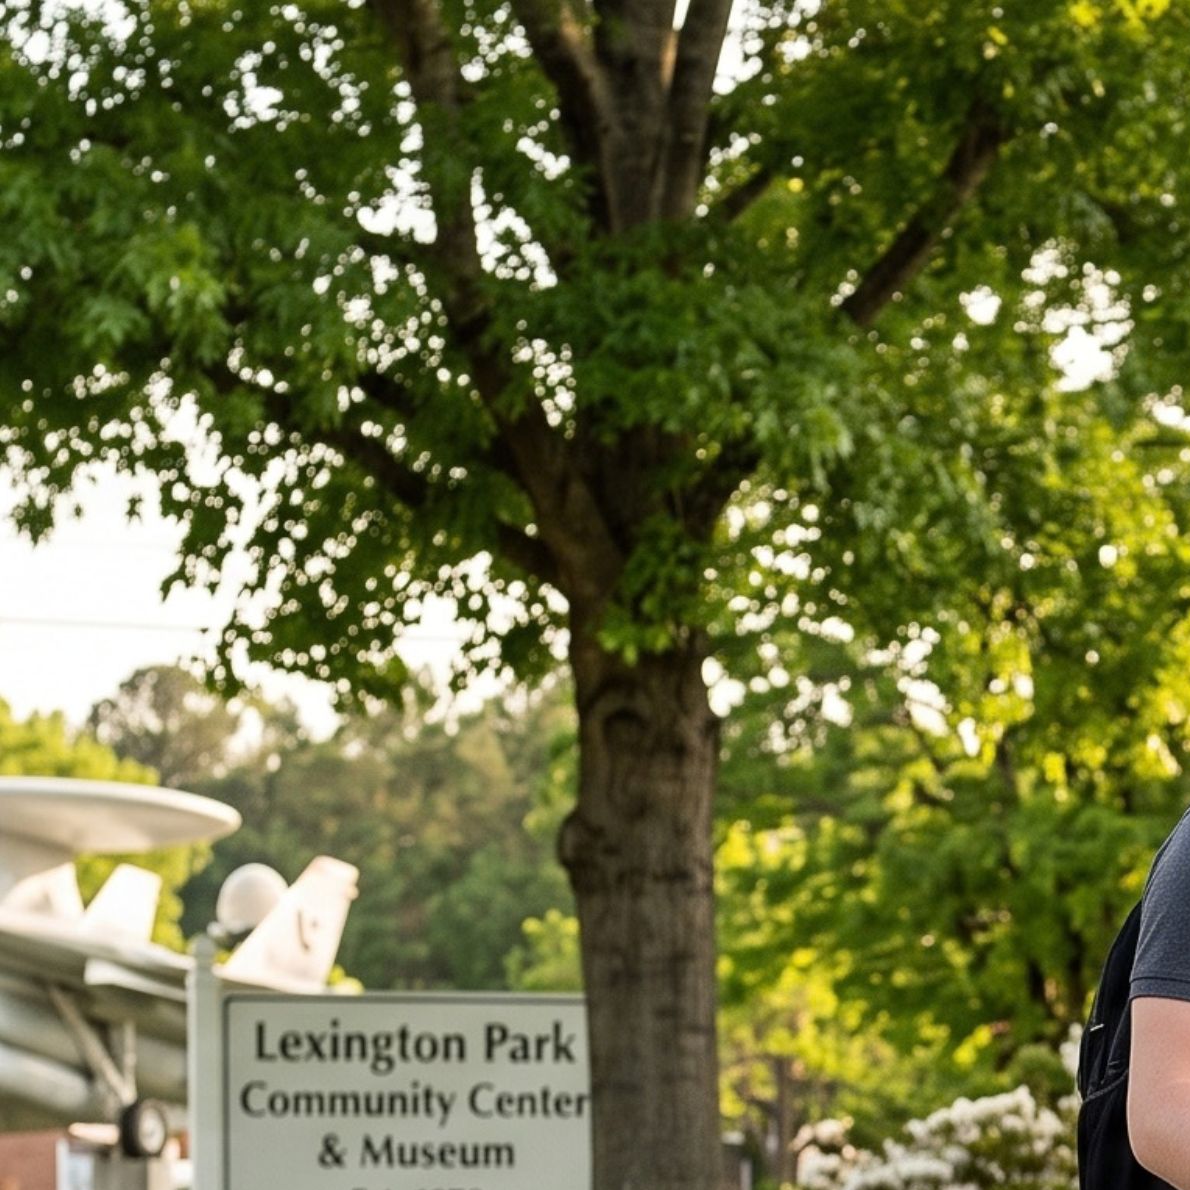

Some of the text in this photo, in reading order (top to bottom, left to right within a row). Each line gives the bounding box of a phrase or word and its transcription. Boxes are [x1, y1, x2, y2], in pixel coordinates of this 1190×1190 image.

[255, 1018, 575, 1074] Lexington Park
[239, 1081, 590, 1127] Community Center
[318, 1134, 515, 1168] & Museum
